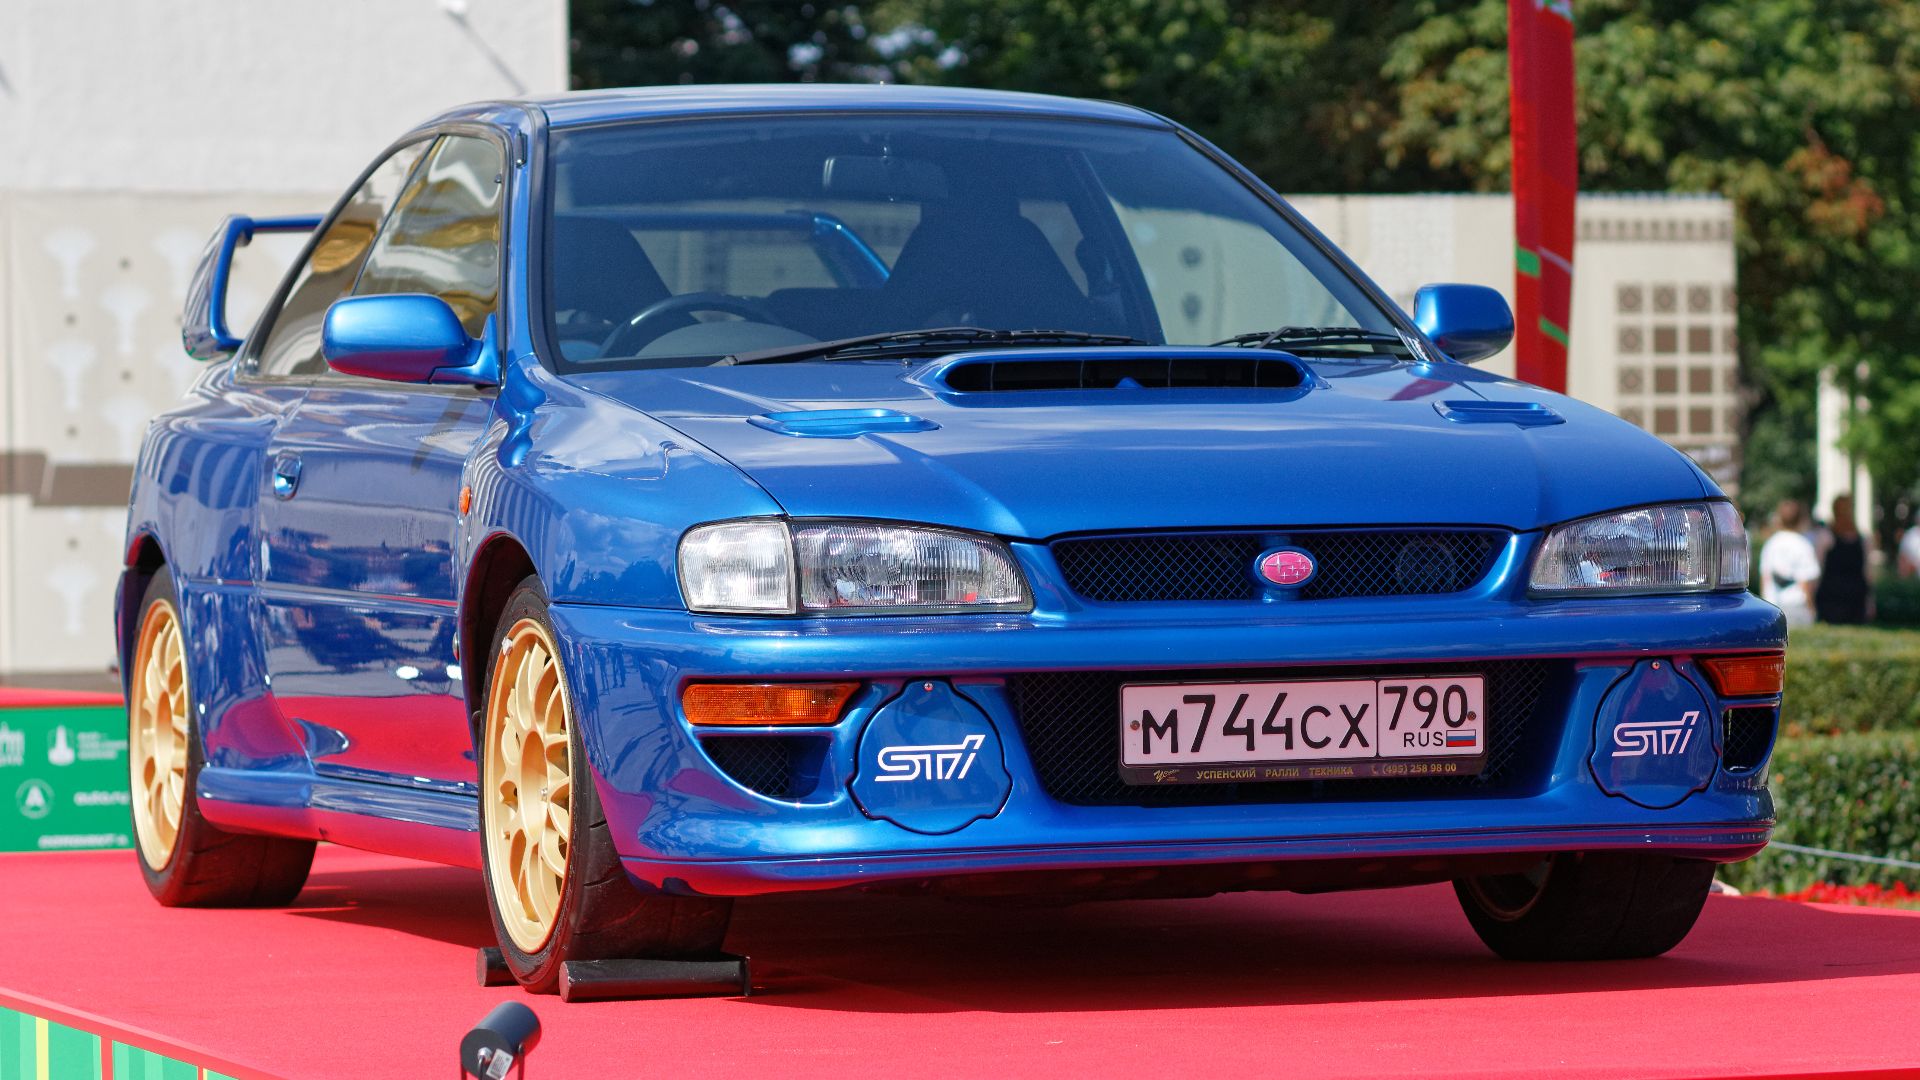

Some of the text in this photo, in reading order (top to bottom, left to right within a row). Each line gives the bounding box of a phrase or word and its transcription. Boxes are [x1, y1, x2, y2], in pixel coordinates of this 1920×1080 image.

[1383, 684, 1468, 731] 790
[1403, 731, 1444, 748] RUS
[1196, 766, 1354, 780] УСПЕНСКИЙ РАЛЛИ ТЕХНИКА
[1410, 763, 1428, 773] 258
[1430, 763, 1442, 773] 98
[1445, 762, 1457, 773] 00
